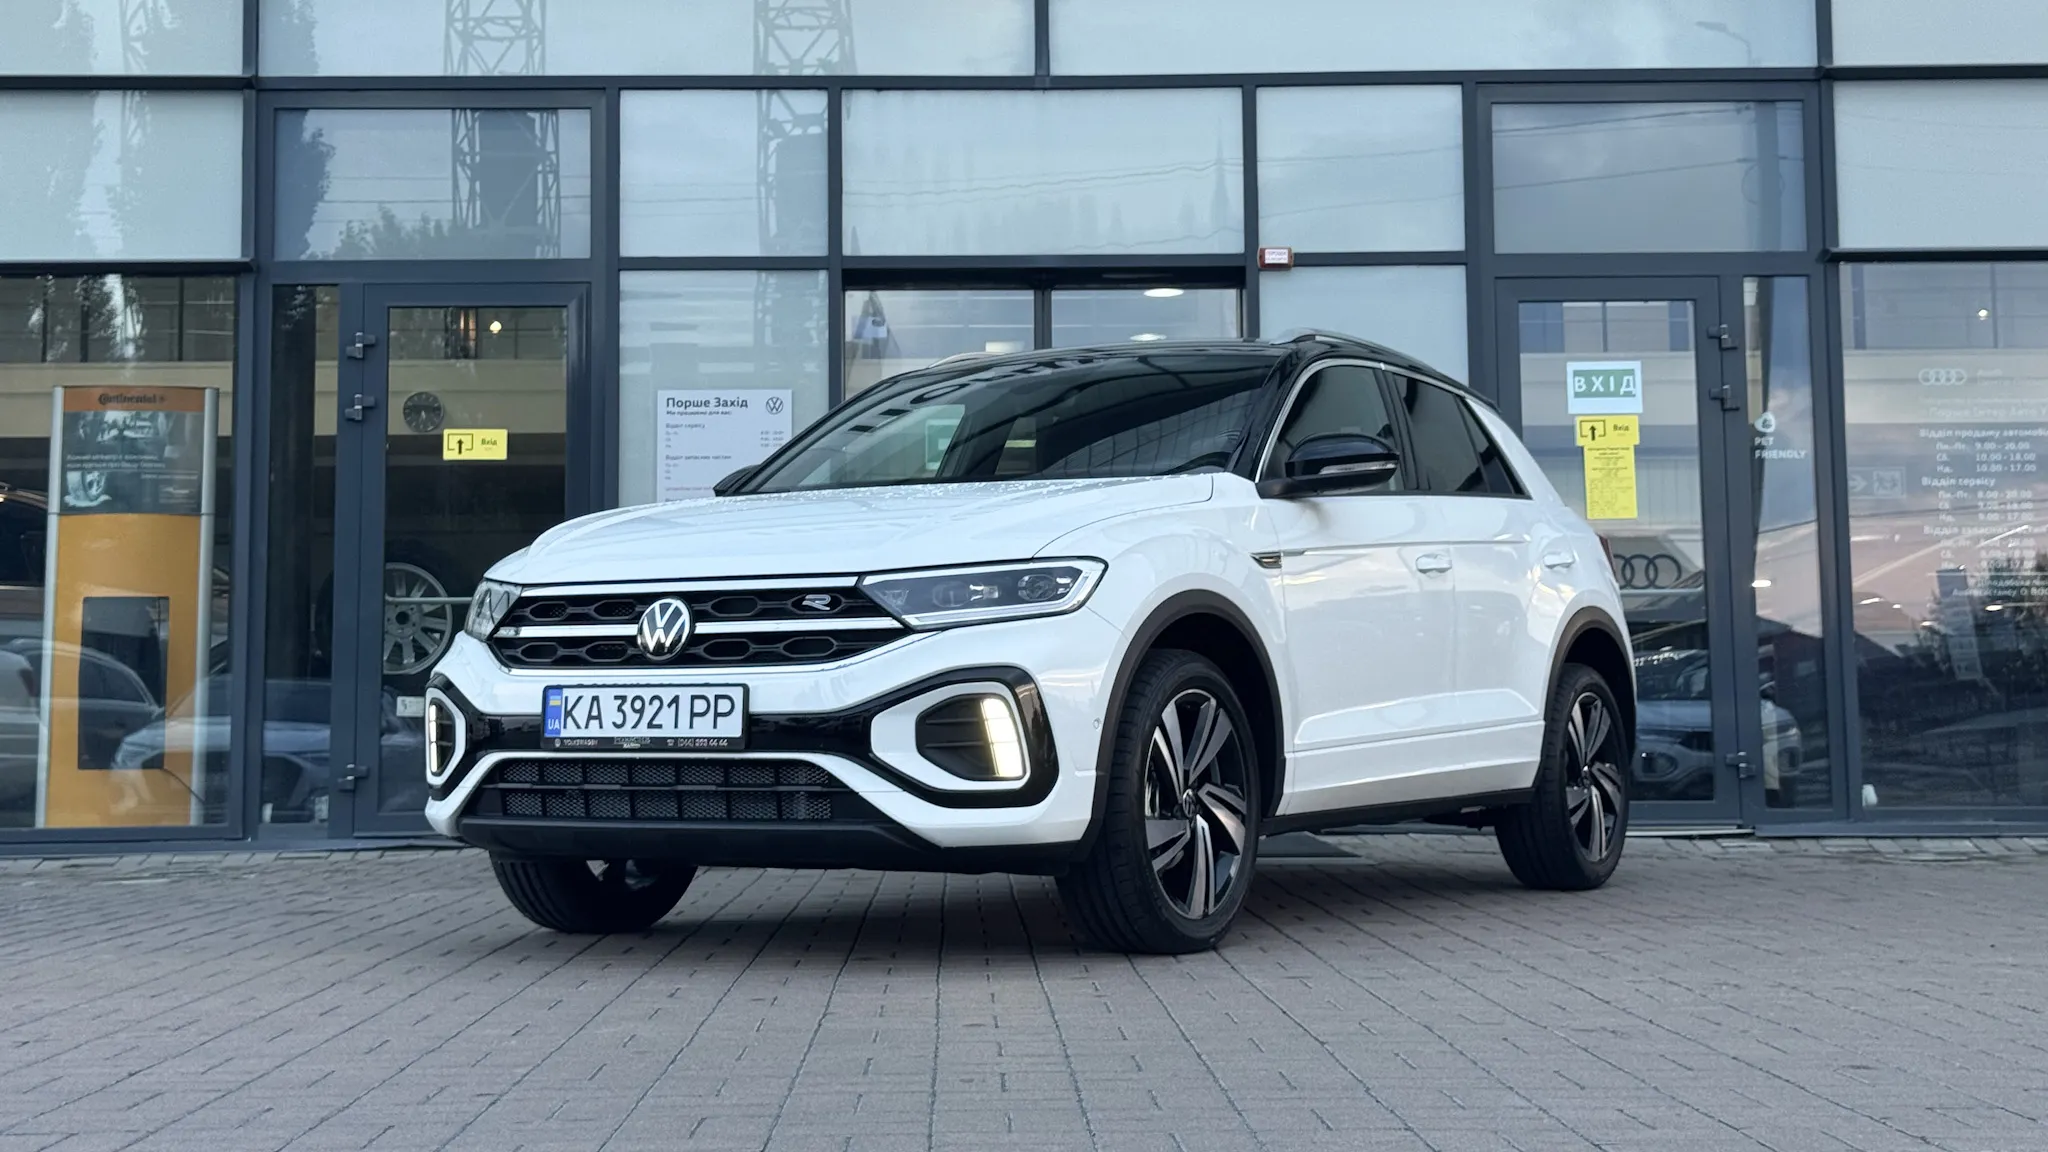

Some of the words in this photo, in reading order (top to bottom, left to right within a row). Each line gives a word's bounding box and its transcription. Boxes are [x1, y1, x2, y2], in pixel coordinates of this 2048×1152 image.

[1574, 375, 1636, 395] ВХІД
[666, 397, 711, 410] Порше
[714, 396, 749, 409] Захід
[1919, 428, 1954, 439] Відділ
[1754, 436, 1775, 446] PET
[1754, 449, 1807, 460] FRIENDLY
[2010, 464, 2037, 472] 17.00
[1921, 476, 1956, 487] Відділ
[1958, 477, 1996, 487] сервісу
[563, 695, 604, 730] KA
[611, 694, 680, 730] 3921
[689, 694, 735, 730] PP
[548, 719, 560, 730] UA
